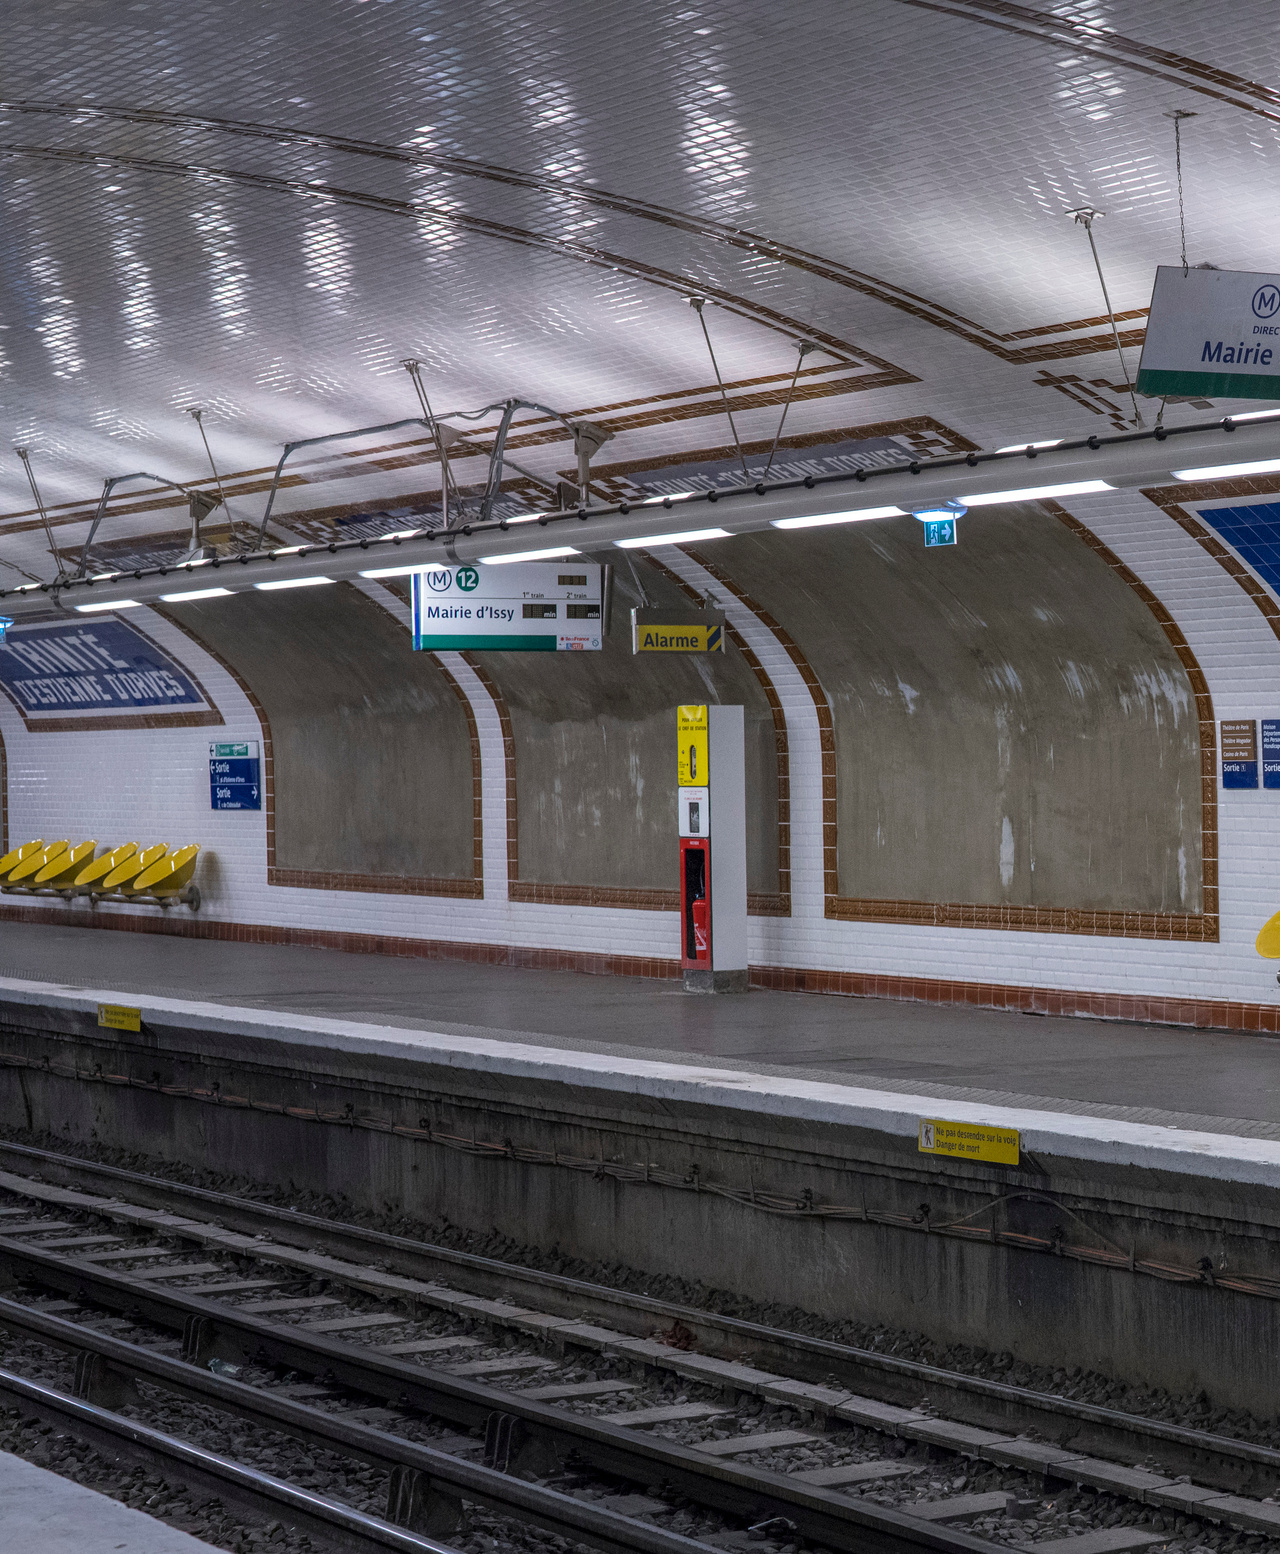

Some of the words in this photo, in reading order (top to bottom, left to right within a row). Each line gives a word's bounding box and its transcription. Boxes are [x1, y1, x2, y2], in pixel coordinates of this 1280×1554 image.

[1201, 340, 1273, 366] Mairie
[457, 572, 476, 587] 12
[427, 605, 473, 619] Mairie
[476, 605, 515, 622] d'Issy
[643, 632, 699, 648] Alarme
[0, 630, 130, 674] TRINITÉ
[13, 675, 112, 704] D'ESTIENNE
[103, 670, 186, 700] D'ORVES
[216, 762, 230, 773] Sortie
[1224, 764, 1240, 772] Sortie
[1264, 764, 1280, 772] Sortie
[216, 787, 230, 798] Sortie
[936, 1126, 944, 1136] Ne
[946, 1129, 956, 1138] pas
[957, 1129, 985, 1141] descendre
[986, 1133, 995, 1142] sur
[996, 1134, 1002, 1143] la
[1003, 1136, 1016, 1146] voie
[936, 1139, 957, 1152] Danger
[958, 1142, 965, 1150] de
[966, 1143, 980, 1153] mort
